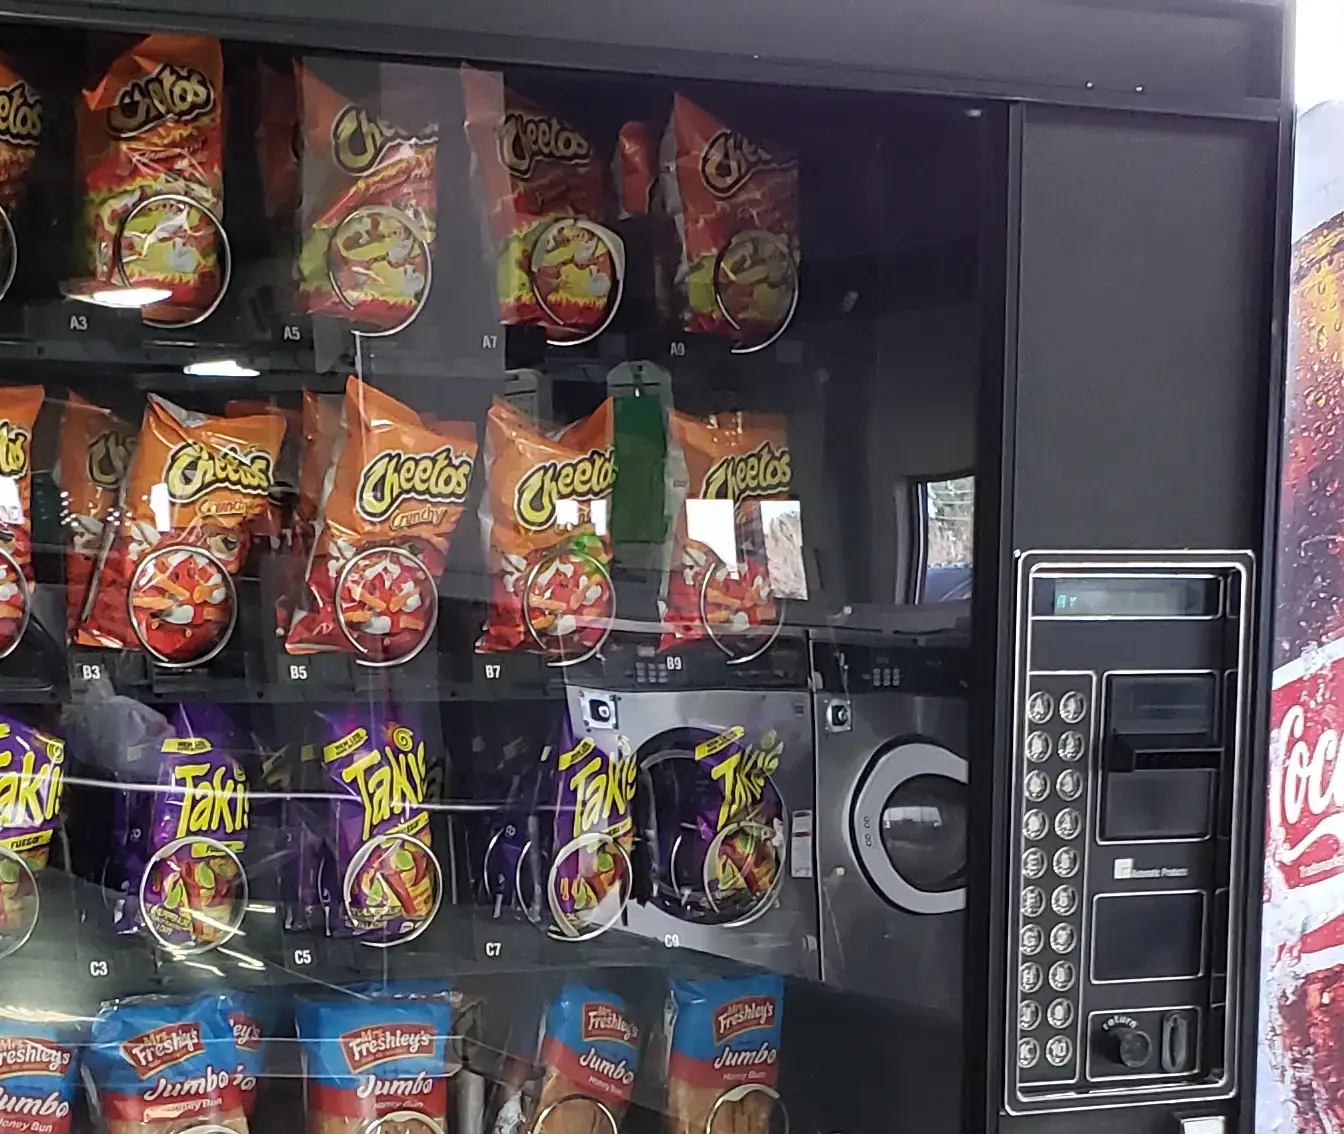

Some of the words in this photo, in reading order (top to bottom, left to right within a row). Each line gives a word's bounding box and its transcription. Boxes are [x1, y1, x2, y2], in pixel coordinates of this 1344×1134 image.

[70, 316, 88, 331] A3
[283, 327, 301, 341] A5
[482, 336, 497, 349] A7
[670, 342, 686, 356] A9
[166, 443, 272, 500] Cheetos
[358, 448, 471, 521] Cheetos
[390, 504, 448, 531] Crunchy
[666, 656, 682, 670] B9
[82, 665, 100, 680] B3
[290, 665, 307, 680] B5
[485, 664, 501, 679] B7
[485, 942, 502, 957] C7
[664, 934, 680, 949] C9
[294, 949, 312, 966] C5
[90, 960, 109, 977] C3
[717, 1001, 775, 1035] Freshley's
[1102, 1014, 1138, 1031] return
[586, 1012, 640, 1041] Freshley's
[348, 1030, 431, 1061] Freshley's
[713, 1043, 777, 1070] Jumbo
[578, 1047, 635, 1085] Jumbo
[143, 1066, 228, 1101] Jumbo
[722, 1072, 747, 1081] Honey
[748, 1071, 766, 1080] Bun
[356, 1071, 433, 1099] Jumbo
[404, 1100, 425, 1109] Bun
[29, 1120, 54, 1134] Bun
